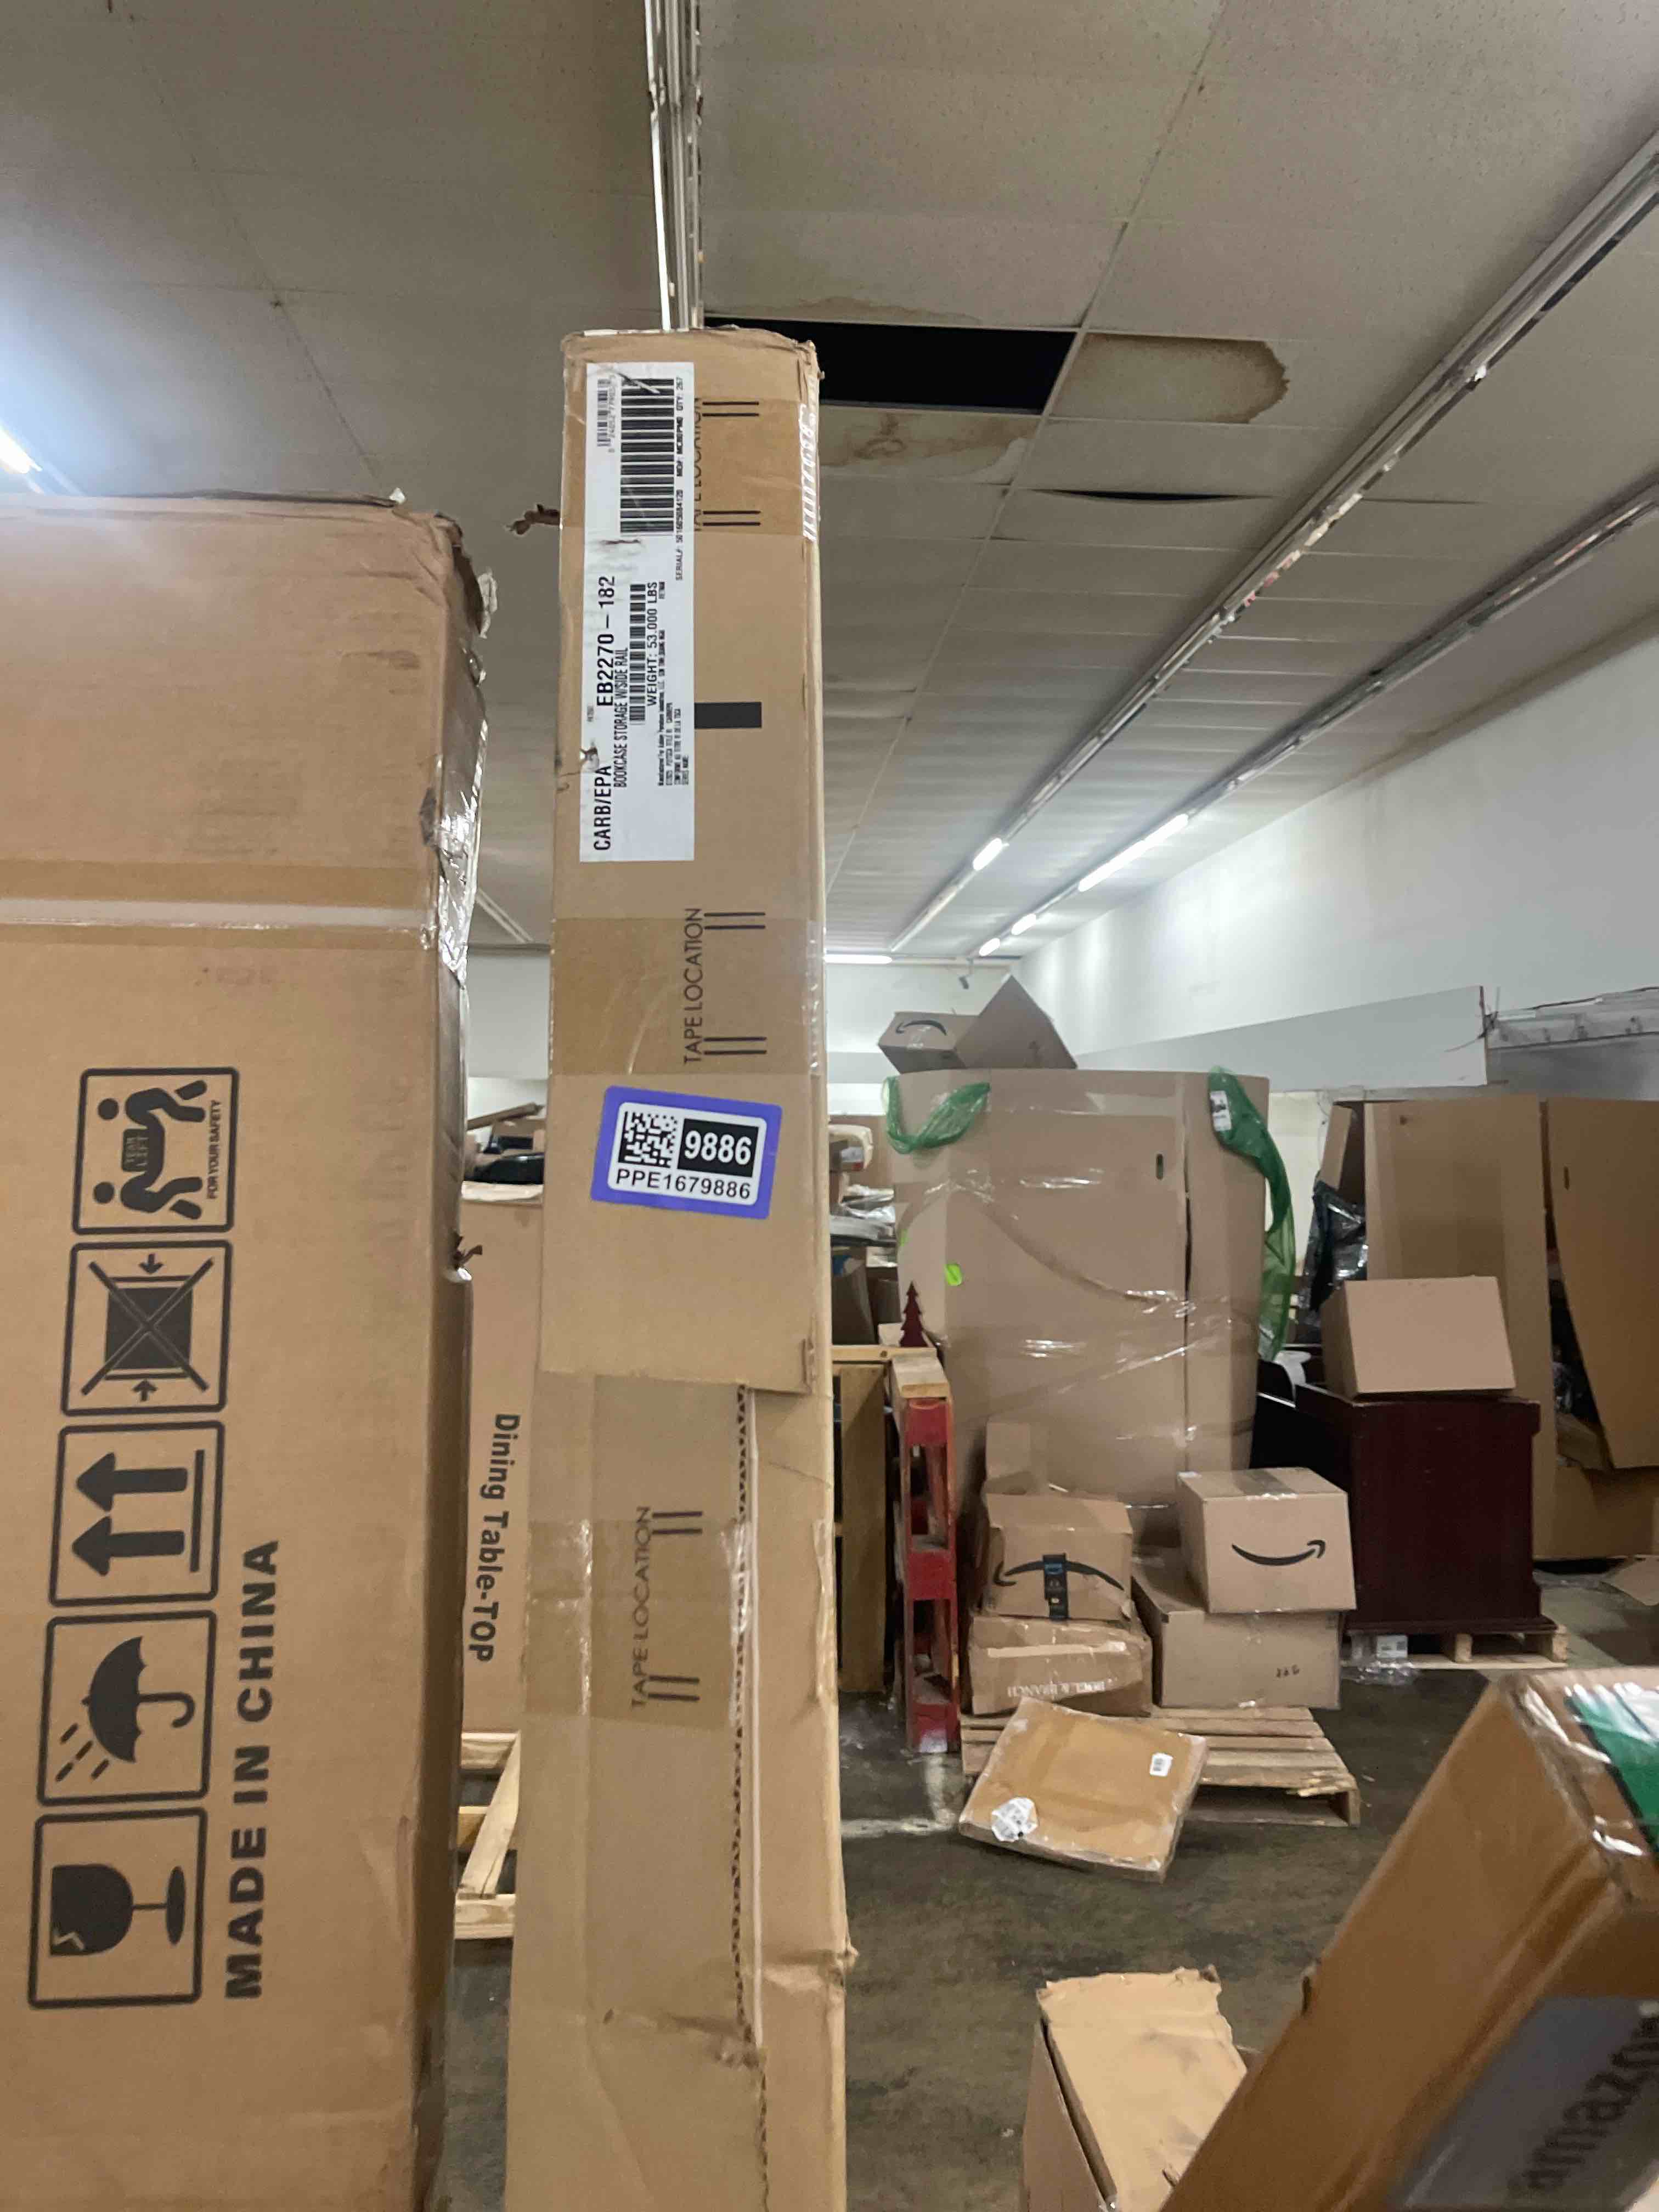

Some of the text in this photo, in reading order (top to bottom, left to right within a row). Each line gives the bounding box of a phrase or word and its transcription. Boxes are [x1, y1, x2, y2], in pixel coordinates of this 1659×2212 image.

[598, 576, 615, 608] 182
[596, 633, 614, 707] EB2270
[646, 582, 658, 707] WEIGHT: 53.000 LBS
[613, 647, 628, 788] BOOKCASE STORAGE W/SIDE RAIL
[593, 765, 611, 851] CARB/EPA
[684, 908, 703, 1065] TAPE LOCATION
[206, 1101, 221, 1199] FOR YOUR SAFETY
[616, 1168, 751, 1199] PPE1679886
[684, 1130, 752, 1166] 9886
[480, 1414, 521, 1499] Dining
[630, 1506, 651, 1708] TAPE LOCATION
[224, 1541, 278, 2000] MADE IN CHINA
